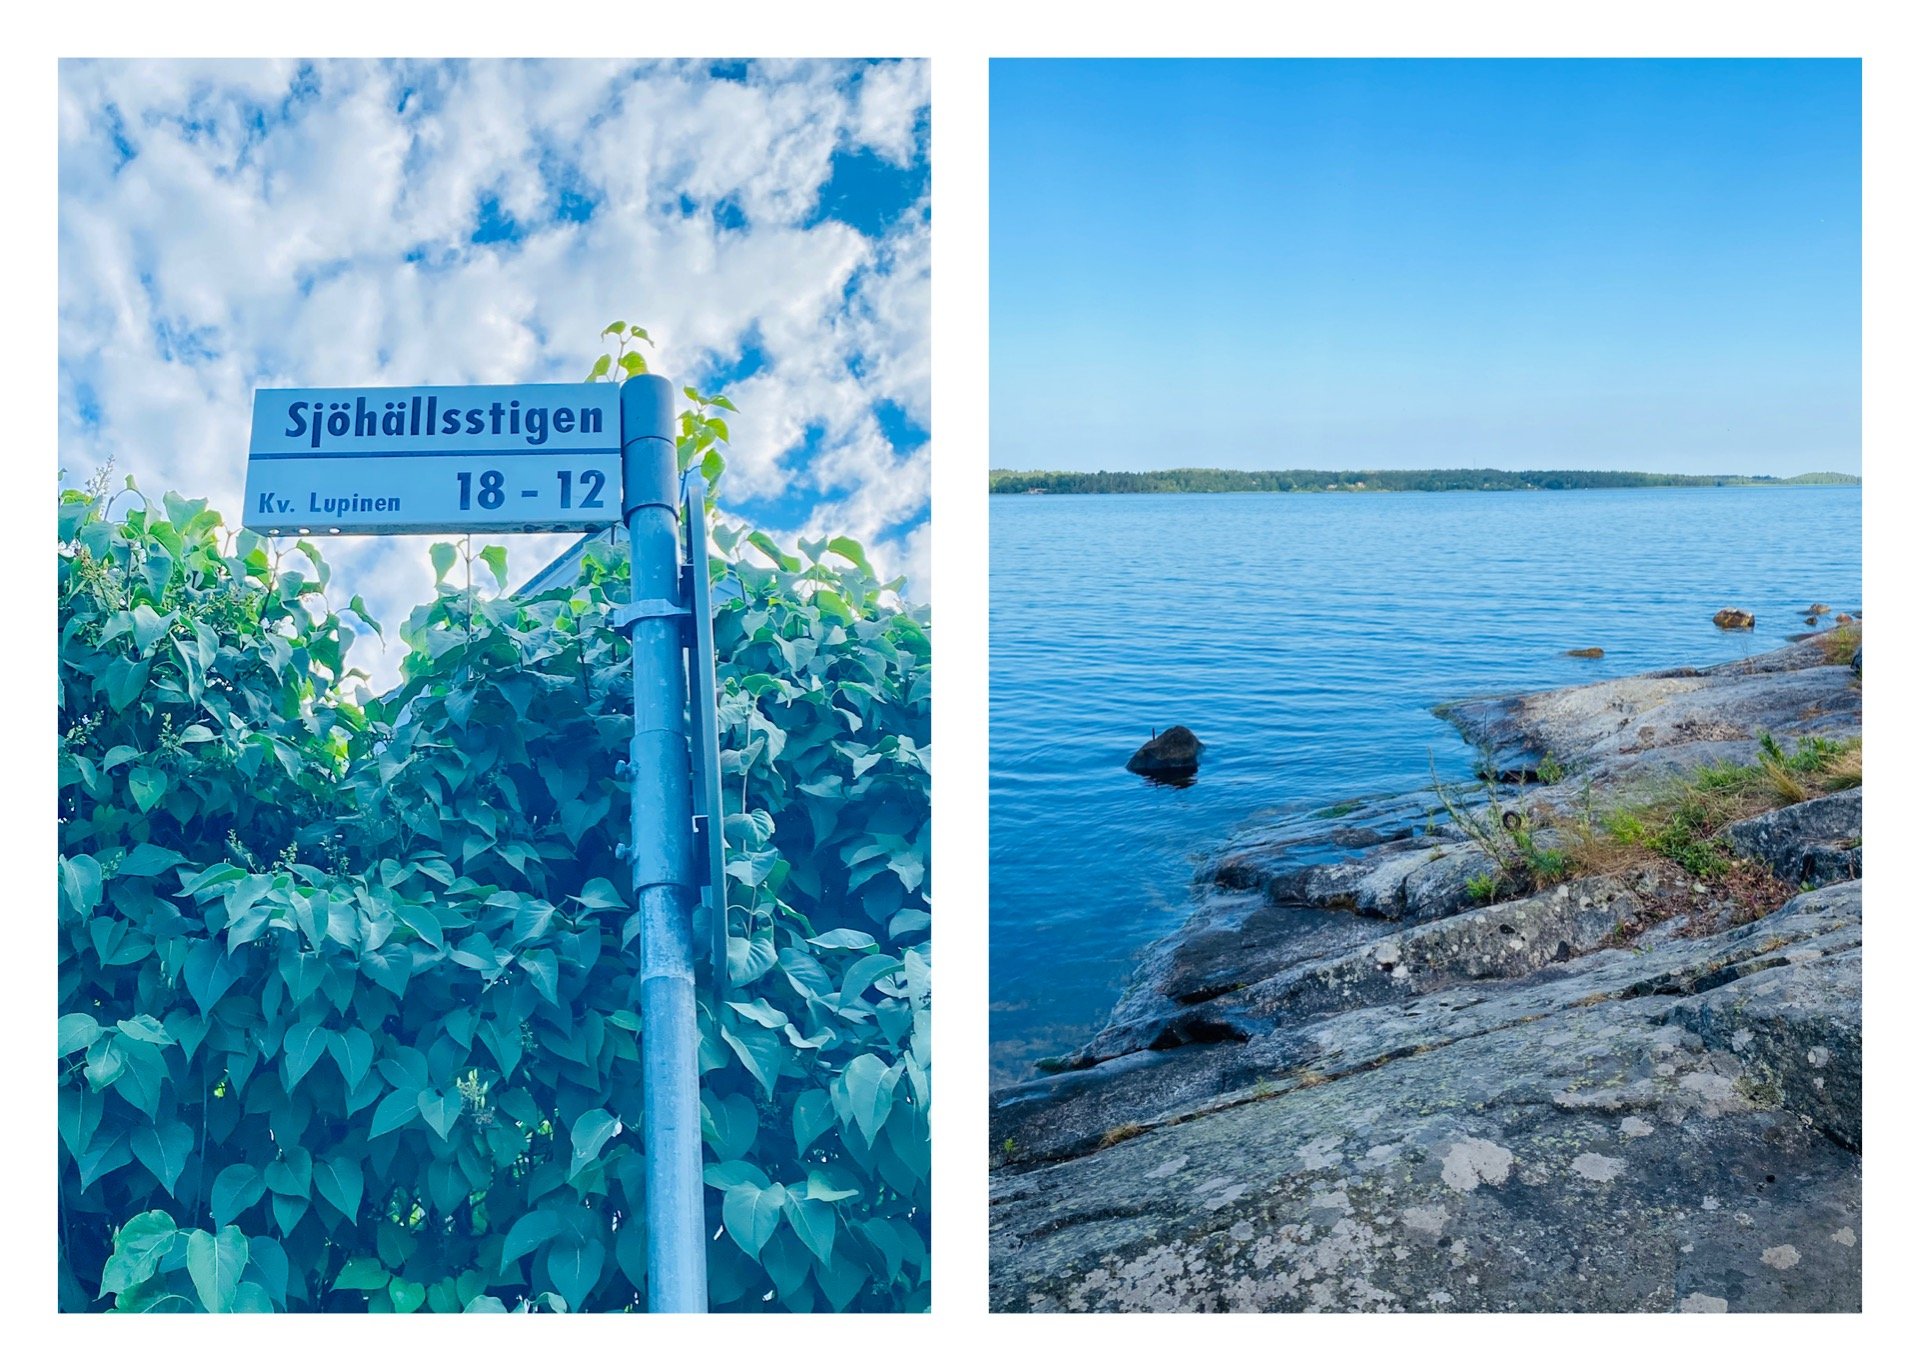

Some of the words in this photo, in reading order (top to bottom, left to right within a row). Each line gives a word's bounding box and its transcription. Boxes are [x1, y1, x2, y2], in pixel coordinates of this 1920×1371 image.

[285, 396, 603, 448] Sjöhällsstigen
[258, 492, 295, 513] Kv.
[309, 492, 401, 517] Lupinen
[456, 471, 505, 511] 18
[556, 470, 606, 509] 12
